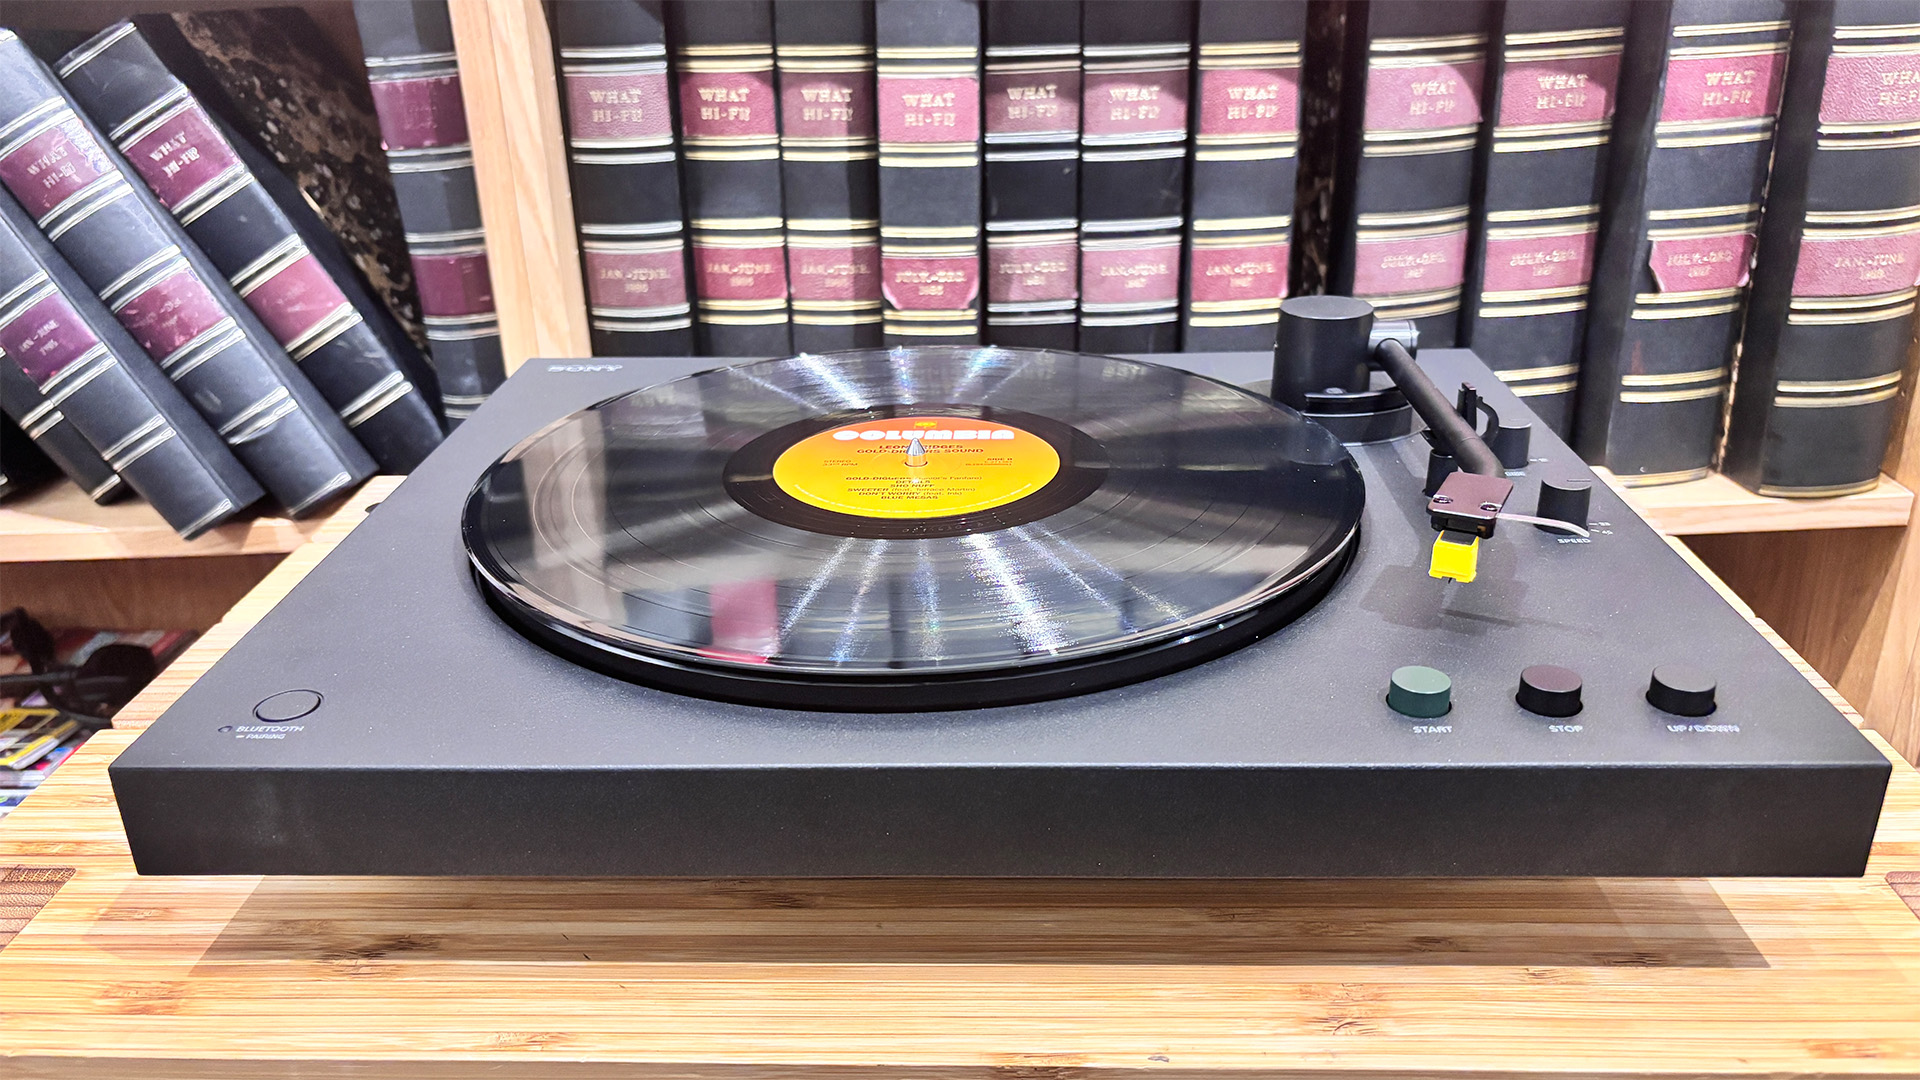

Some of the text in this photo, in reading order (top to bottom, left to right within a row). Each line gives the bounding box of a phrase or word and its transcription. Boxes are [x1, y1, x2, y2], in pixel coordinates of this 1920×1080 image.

[1537, 73, 1588, 90] WHAT
[1705, 69, 1756, 86] WHAT
[1881, 70, 1920, 86] WHA
[697, 87, 751, 103] WHAT
[801, 87, 853, 103] WHAT
[1007, 84, 1058, 101] WHAT
[1109, 85, 1161, 101] WHAT
[1227, 83, 1278, 101] WHAT
[1410, 79, 1457, 96] WHAT
[589, 88, 643, 104] WHAT
[901, 92, 956, 107] WHAT
[149, 131, 188, 163] WHAT
[26, 146, 68, 177] WHAT
[547, 364, 623, 373] SONY
[832, 430, 1015, 441] COLUMBIA
[235, 725, 305, 733] BLUETOOTH
[1412, 724, 1453, 734] START
[1549, 724, 1583, 733] STOP
